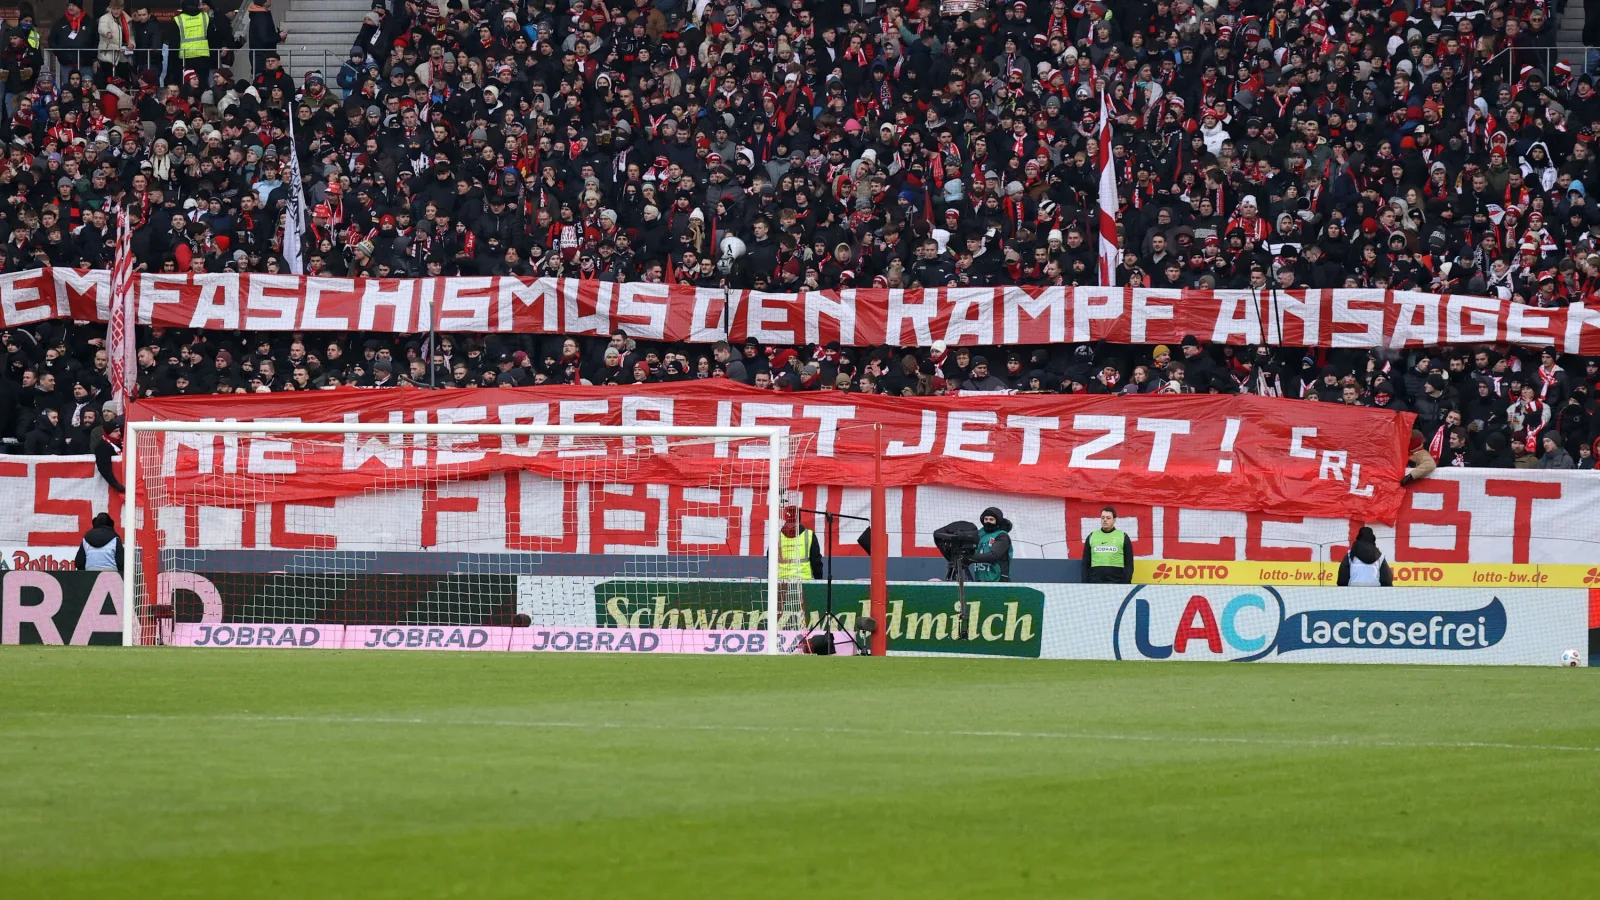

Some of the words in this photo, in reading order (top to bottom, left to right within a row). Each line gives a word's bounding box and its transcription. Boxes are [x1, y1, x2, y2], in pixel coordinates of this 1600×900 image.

[136, 272, 671, 340] FASCHISMUS
[690, 286, 857, 344] DEN
[886, 285, 1183, 344] KAMPF
[161, 416, 302, 477] NIE
[342, 396, 676, 470] WIEDER
[713, 400, 857, 459] IST
[885, 409, 1191, 473] JETZT
[1176, 564, 1229, 580] LOTTO
[1259, 568, 1333, 584] lotto-bw.de
[1473, 569, 1548, 584] lotto-bw.de
[194, 626, 321, 647] JOBRAD
[1136, 595, 1267, 659] LAC
[1301, 613, 1489, 648] lactosefrei
[364, 629, 489, 649] JOBRAD
[532, 631, 660, 652] JOBRAD
